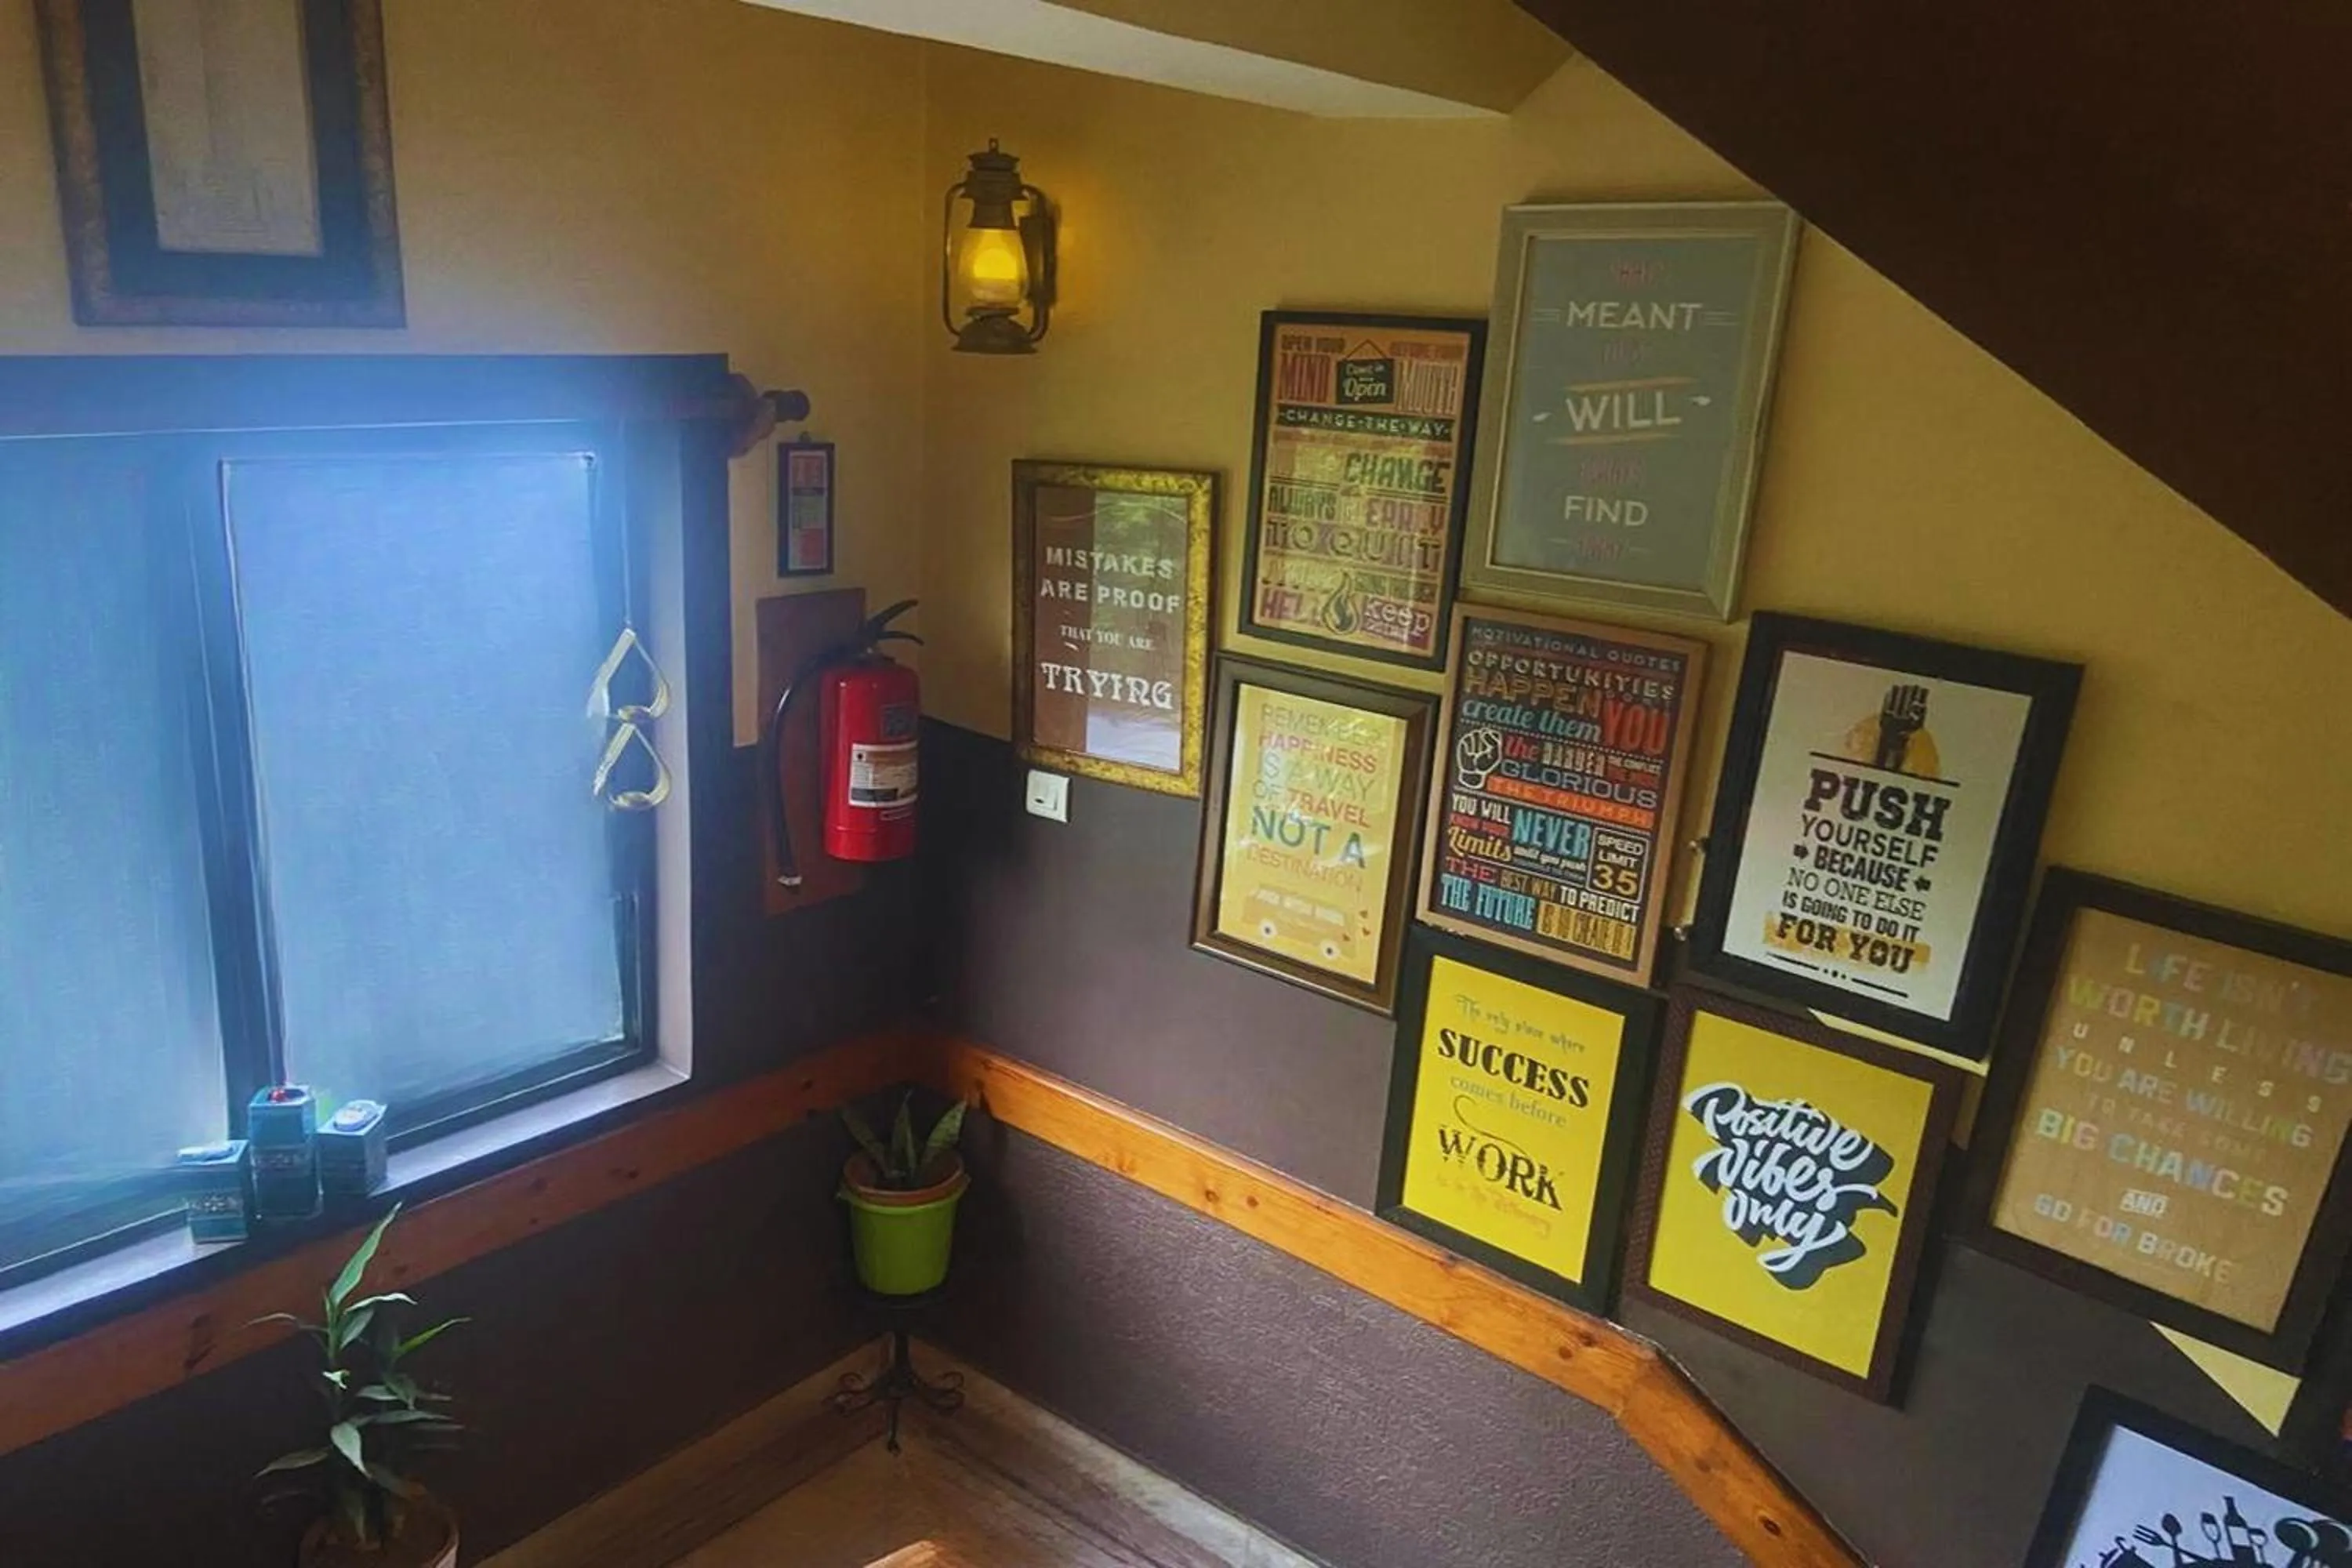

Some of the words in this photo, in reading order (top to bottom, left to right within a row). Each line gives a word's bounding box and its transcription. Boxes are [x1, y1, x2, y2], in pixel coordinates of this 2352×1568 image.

[1566, 301, 1703, 330] MEANT
[1343, 377, 1386, 401] Open
[1566, 390, 1682, 431] WILL
[1286, 409, 1356, 429] CHANGE
[1366, 418, 1399, 433] THE
[1410, 421, 1446, 437] WAY
[1343, 452, 1451, 494] CHANGE
[1563, 495, 1649, 527] FIND
[1046, 546, 1174, 580] MISTAKES
[1040, 578, 1088, 601] ARE
[1098, 585, 1181, 613] PROOF
[1060, 624, 1093, 642] THAT
[1095, 628, 1121, 647] YOU
[1129, 633, 1155, 651] ARE
[1471, 626, 1599, 659] MOTIVATIONAL
[1607, 648, 1682, 673] QUOTES
[1040, 662, 1174, 710] TRYING
[1463, 666, 1602, 719] HAPPEN
[1468, 649, 1675, 700] OPPORTUNITIES
[1461, 699, 1534, 729] create
[1538, 710, 1602, 743] them
[1602, 697, 1670, 757] YOU
[1257, 747, 1281, 780] IS
[1258, 729, 1377, 775] HAPPINESS
[1504, 733, 1540, 763] the
[1251, 778, 1286, 801] OF
[1286, 787, 1371, 829] TRAVEL
[1500, 759, 1657, 808] GLORIOUS
[1804, 768, 1953, 842] PUSH
[1251, 804, 1332, 855] NOT
[1340, 830, 1367, 869] A
[1447, 825, 1512, 862] Limits
[1452, 793, 1477, 815] YOU
[1480, 800, 1512, 825] WILL
[1512, 808, 1591, 861] NEVER
[1597, 833, 1645, 856] SPEED
[1802, 813, 1939, 868] YOURSELF
[1592, 864, 1639, 897] 35
[1598, 849, 1639, 869] LIMIT
[1813, 844, 1911, 892] BECAUSE
[1439, 872, 1472, 914] THE
[1474, 884, 1537, 931] FUTURE
[1446, 855, 1497, 884] THE
[1559, 885, 1578, 906] TO
[1578, 891, 1641, 924] PREDICT
[1787, 866, 1820, 892] NO
[1824, 877, 1871, 906] ONE
[1874, 888, 1927, 922] ELSE
[1782, 890, 1798, 909] IS
[1801, 895, 1849, 924] GOING
[1852, 909, 1875, 931] TO
[1875, 916, 1900, 938] DO
[1902, 924, 1921, 944] IT
[1775, 912, 1840, 953] FOR
[1849, 931, 1916, 975] YOU
[2068, 973, 2211, 1041] WORTH
[1438, 1027, 1590, 1109] SUCCESS
[1450, 1076, 1504, 1104] comes
[1508, 1091, 1568, 1130] before
[2056, 1045, 2114, 1083] YOU
[2118, 1067, 2178, 1104] ARE
[2186, 1087, 2313, 1148] WILLING
[1681, 1080, 1875, 1171] Positive
[1438, 1124, 1566, 1212] WORK
[1691, 1137, 1879, 1212] Vibes
[2034, 1106, 2100, 1151] BIG
[2107, 1131, 2289, 1218] CHANCES
[2120, 1188, 2170, 1219] AND
[2033, 1192, 2073, 1224] GO
[2075, 1207, 2132, 1247] FOR
[2136, 1230, 2234, 1285] BROKE
